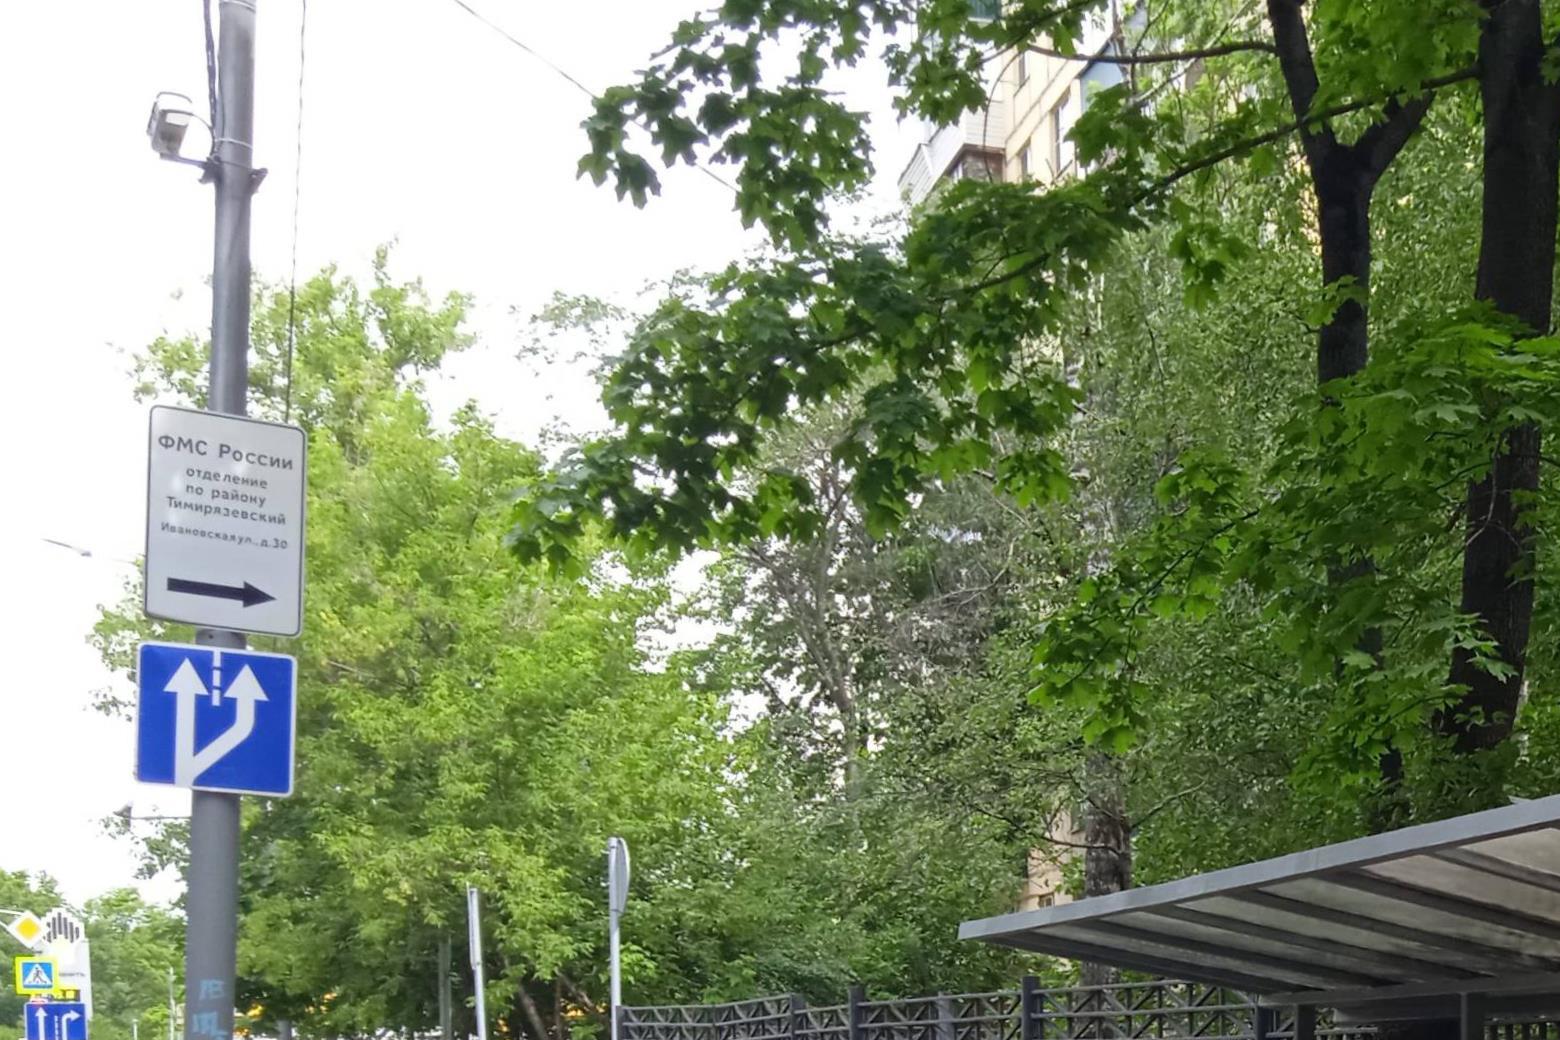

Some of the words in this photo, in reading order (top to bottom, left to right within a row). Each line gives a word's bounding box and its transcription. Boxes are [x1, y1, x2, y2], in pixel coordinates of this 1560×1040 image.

[158, 435, 208, 456] ФМС
[219, 443, 293, 470] России
[186, 468, 268, 489] отделение
[186, 484, 204, 496] по
[211, 489, 266, 508] району
[166, 496, 286, 525] Тимирязевский
[161, 521, 236, 542] Ивановская
